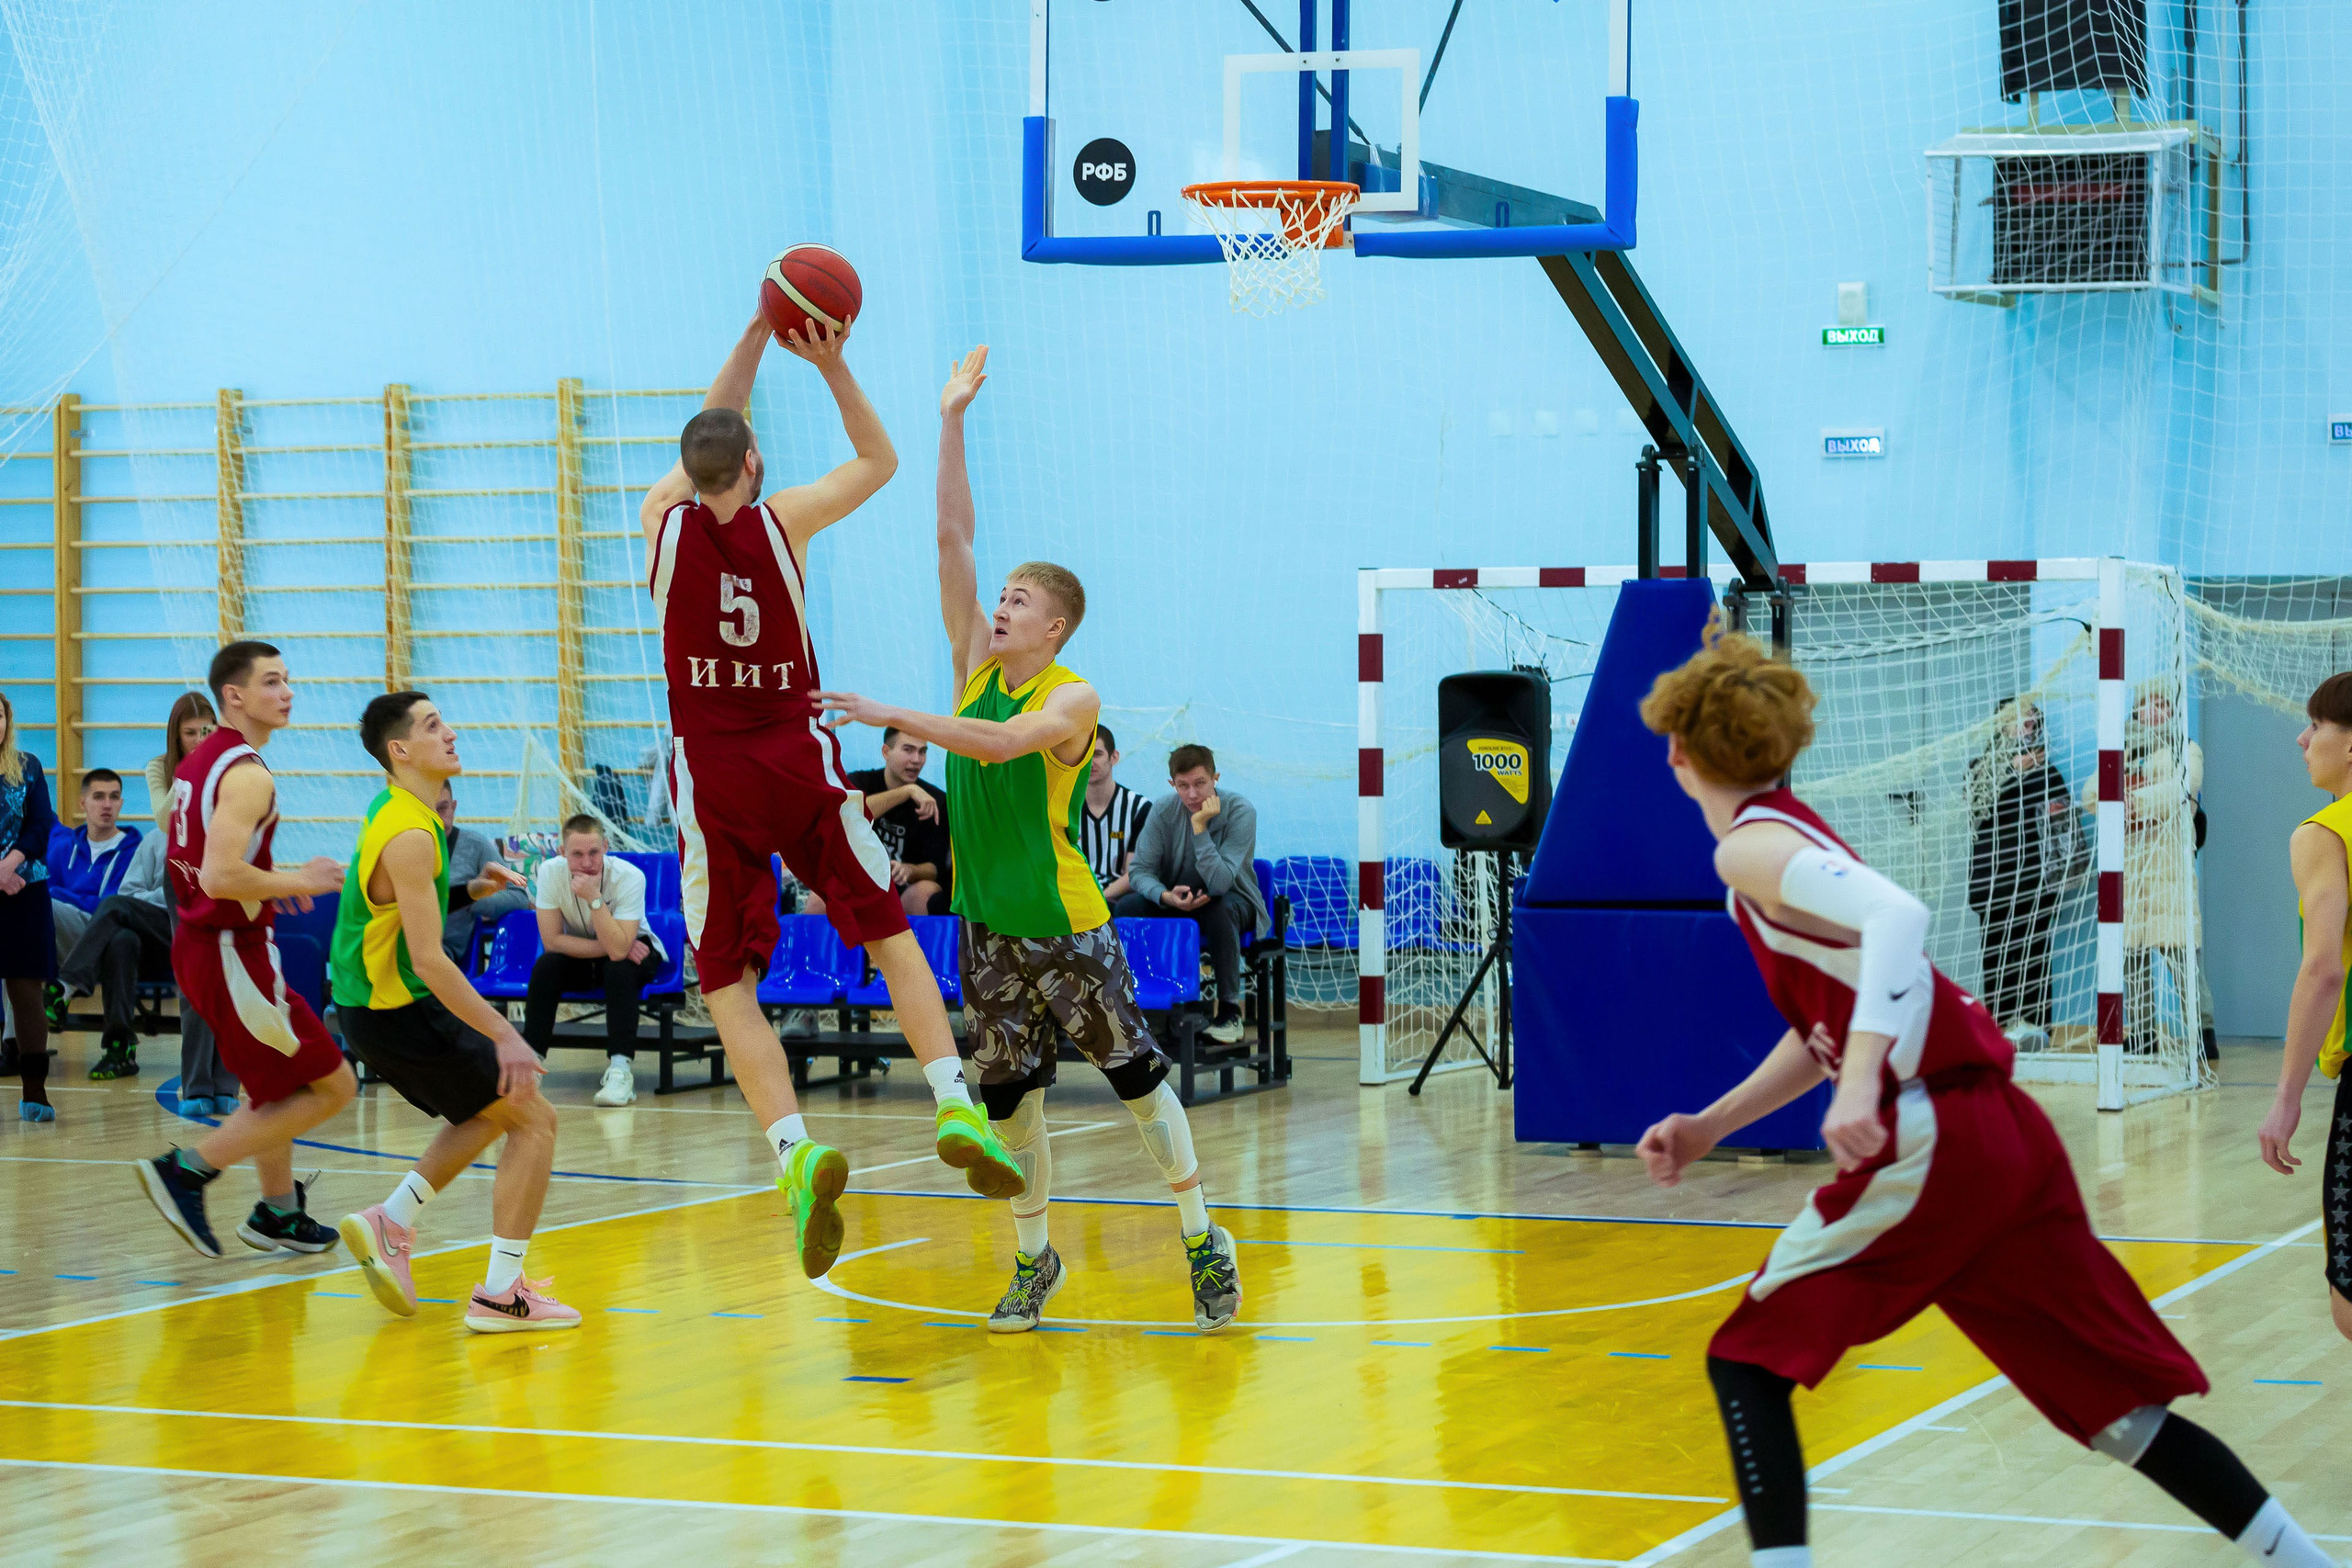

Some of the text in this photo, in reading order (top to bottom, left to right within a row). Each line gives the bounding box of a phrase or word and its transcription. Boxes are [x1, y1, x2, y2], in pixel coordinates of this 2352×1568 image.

[1081, 162, 1127, 181] РФБ
[1826, 329, 1880, 344] ВЫХОД
[1827, 437, 1881, 454] ВЫХОД
[718, 571, 760, 648] 5
[1472, 753, 1523, 772] 1000
